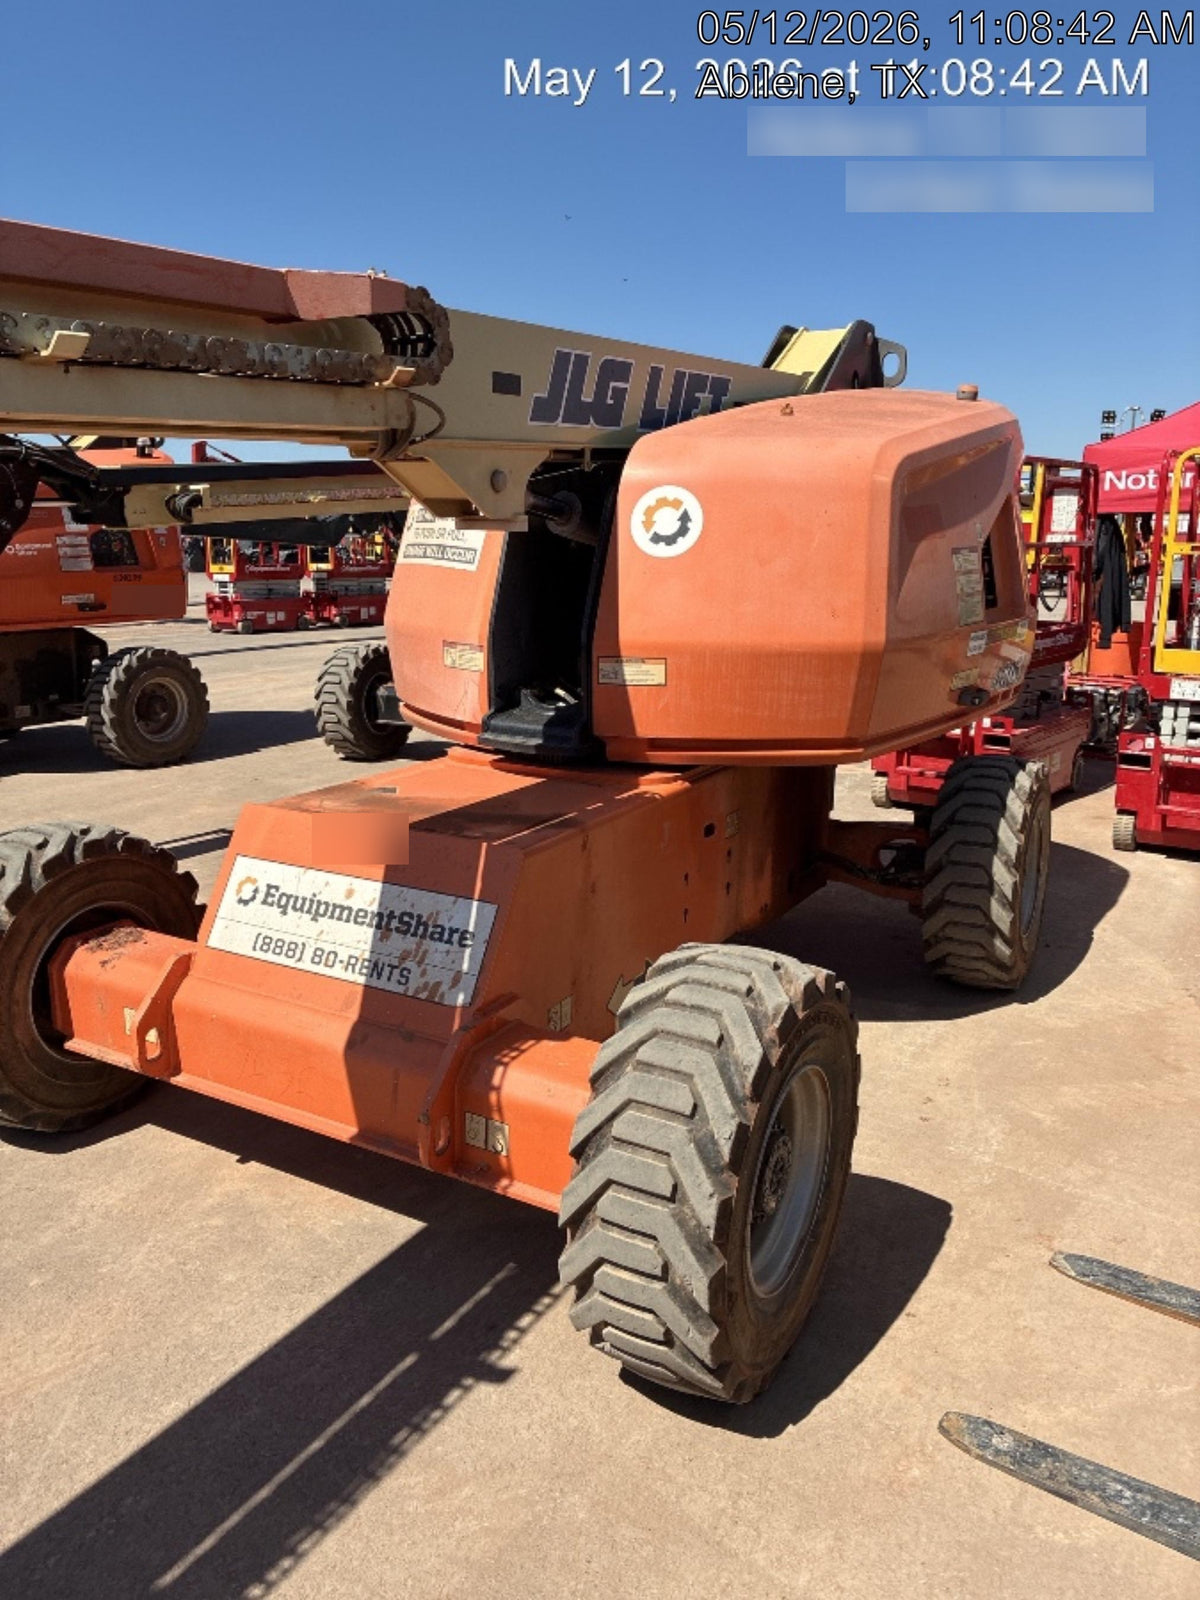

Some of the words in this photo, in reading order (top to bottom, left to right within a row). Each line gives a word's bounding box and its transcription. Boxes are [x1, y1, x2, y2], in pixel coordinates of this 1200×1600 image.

[528, 347, 634, 429] JLG
[636, 363, 733, 432] LIFT
[261, 883, 475, 948] EquipmentShare
[252, 932, 305, 964] (888)
[310, 948, 411, 986] 80-RENTS
